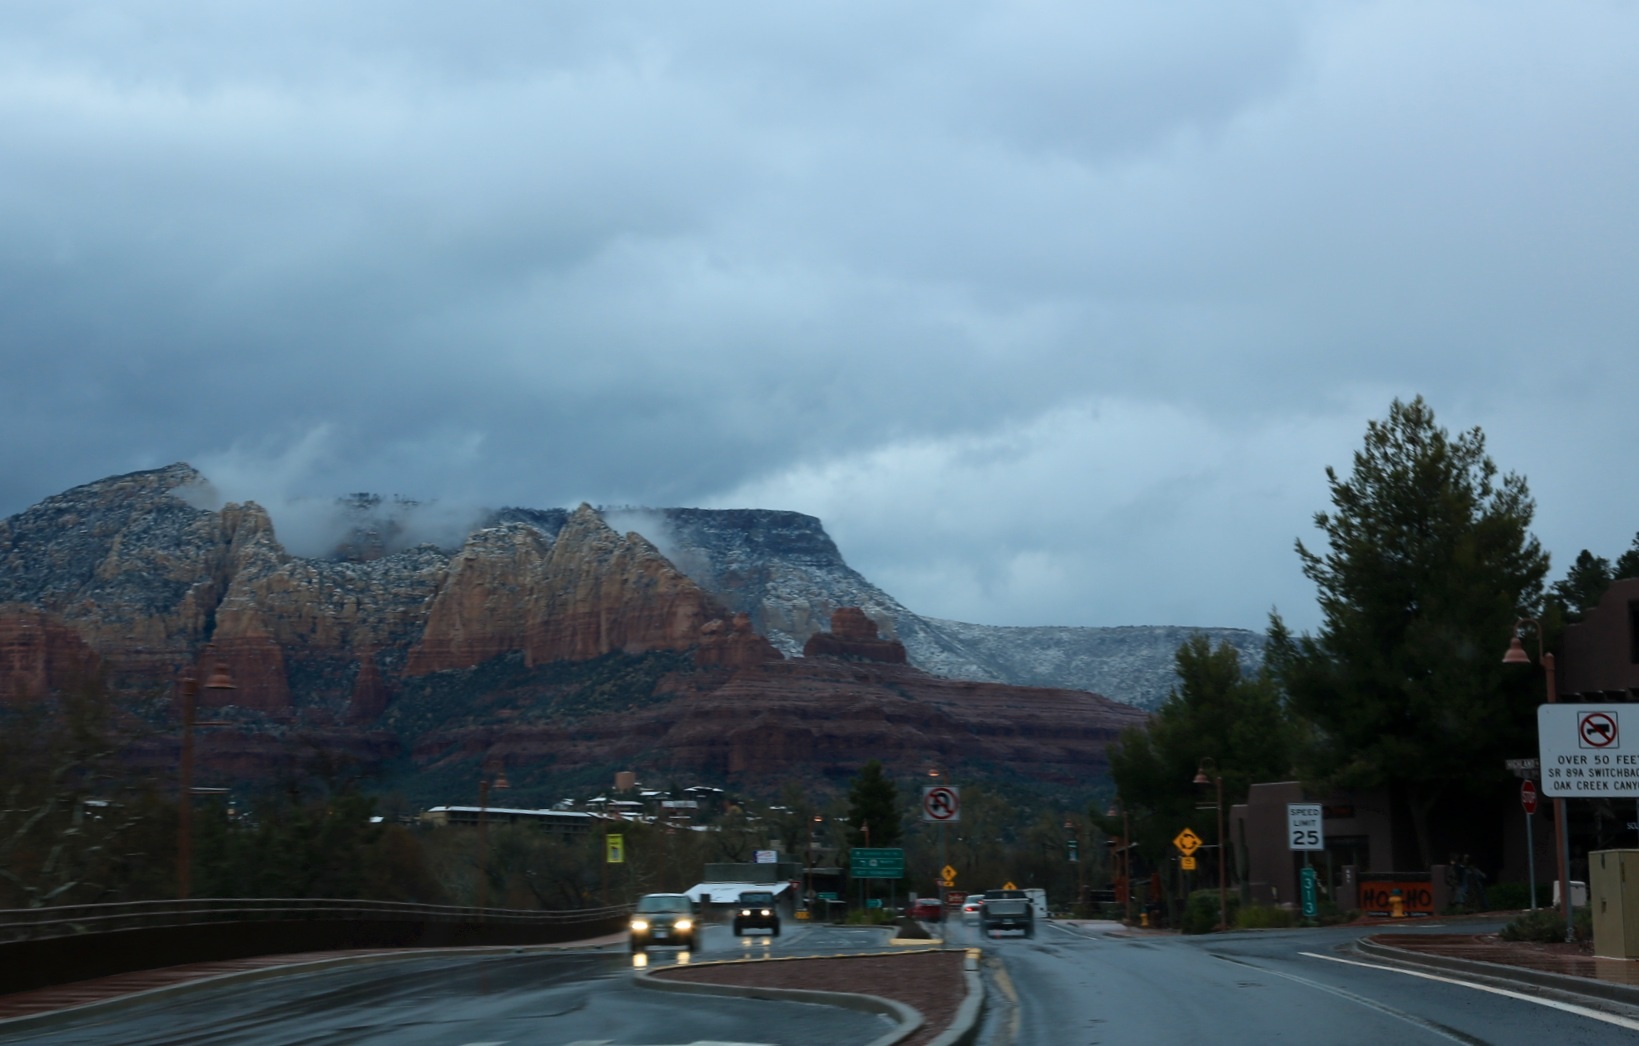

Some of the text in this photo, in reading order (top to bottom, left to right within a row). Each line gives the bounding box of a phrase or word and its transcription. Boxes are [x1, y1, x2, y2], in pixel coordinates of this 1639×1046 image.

[1557, 755, 1587, 765] OVER
[1594, 755, 1610, 765] 50
[1548, 768, 1561, 778] SR
[1566, 768, 1584, 778] 89A
[1553, 781, 1639, 791] OAK CREEK CANY
[1521, 790, 1537, 804] STOP
[1290, 808, 1319, 816] SPEED
[1293, 819, 1316, 827] LIMIT
[1293, 830, 1319, 845] 25
